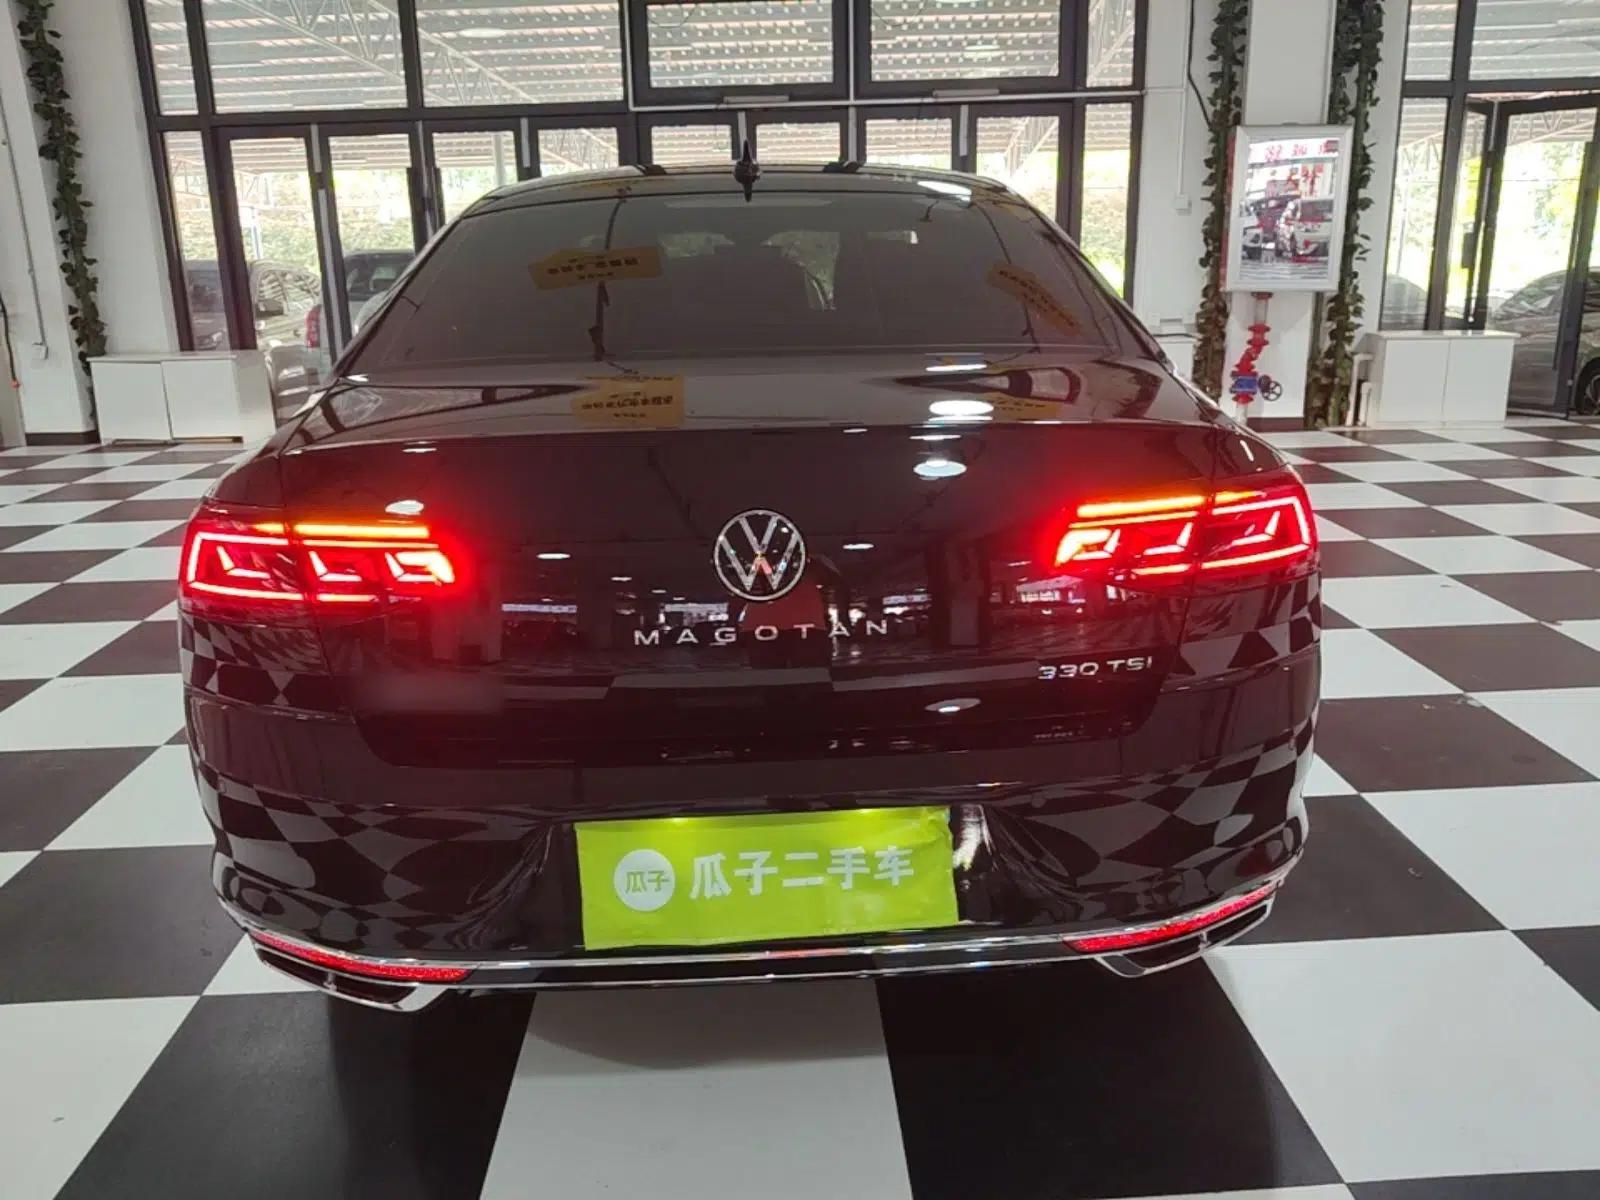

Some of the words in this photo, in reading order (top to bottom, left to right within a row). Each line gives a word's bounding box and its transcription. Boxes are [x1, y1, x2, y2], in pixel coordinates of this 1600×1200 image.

[633, 619, 887, 646] MAGOTAN
[1038, 661, 1099, 680] 330
[1106, 655, 1153, 673] TSI
[625, 870, 670, 894] 瓜子
[689, 845, 915, 900] 瓜子二手车
